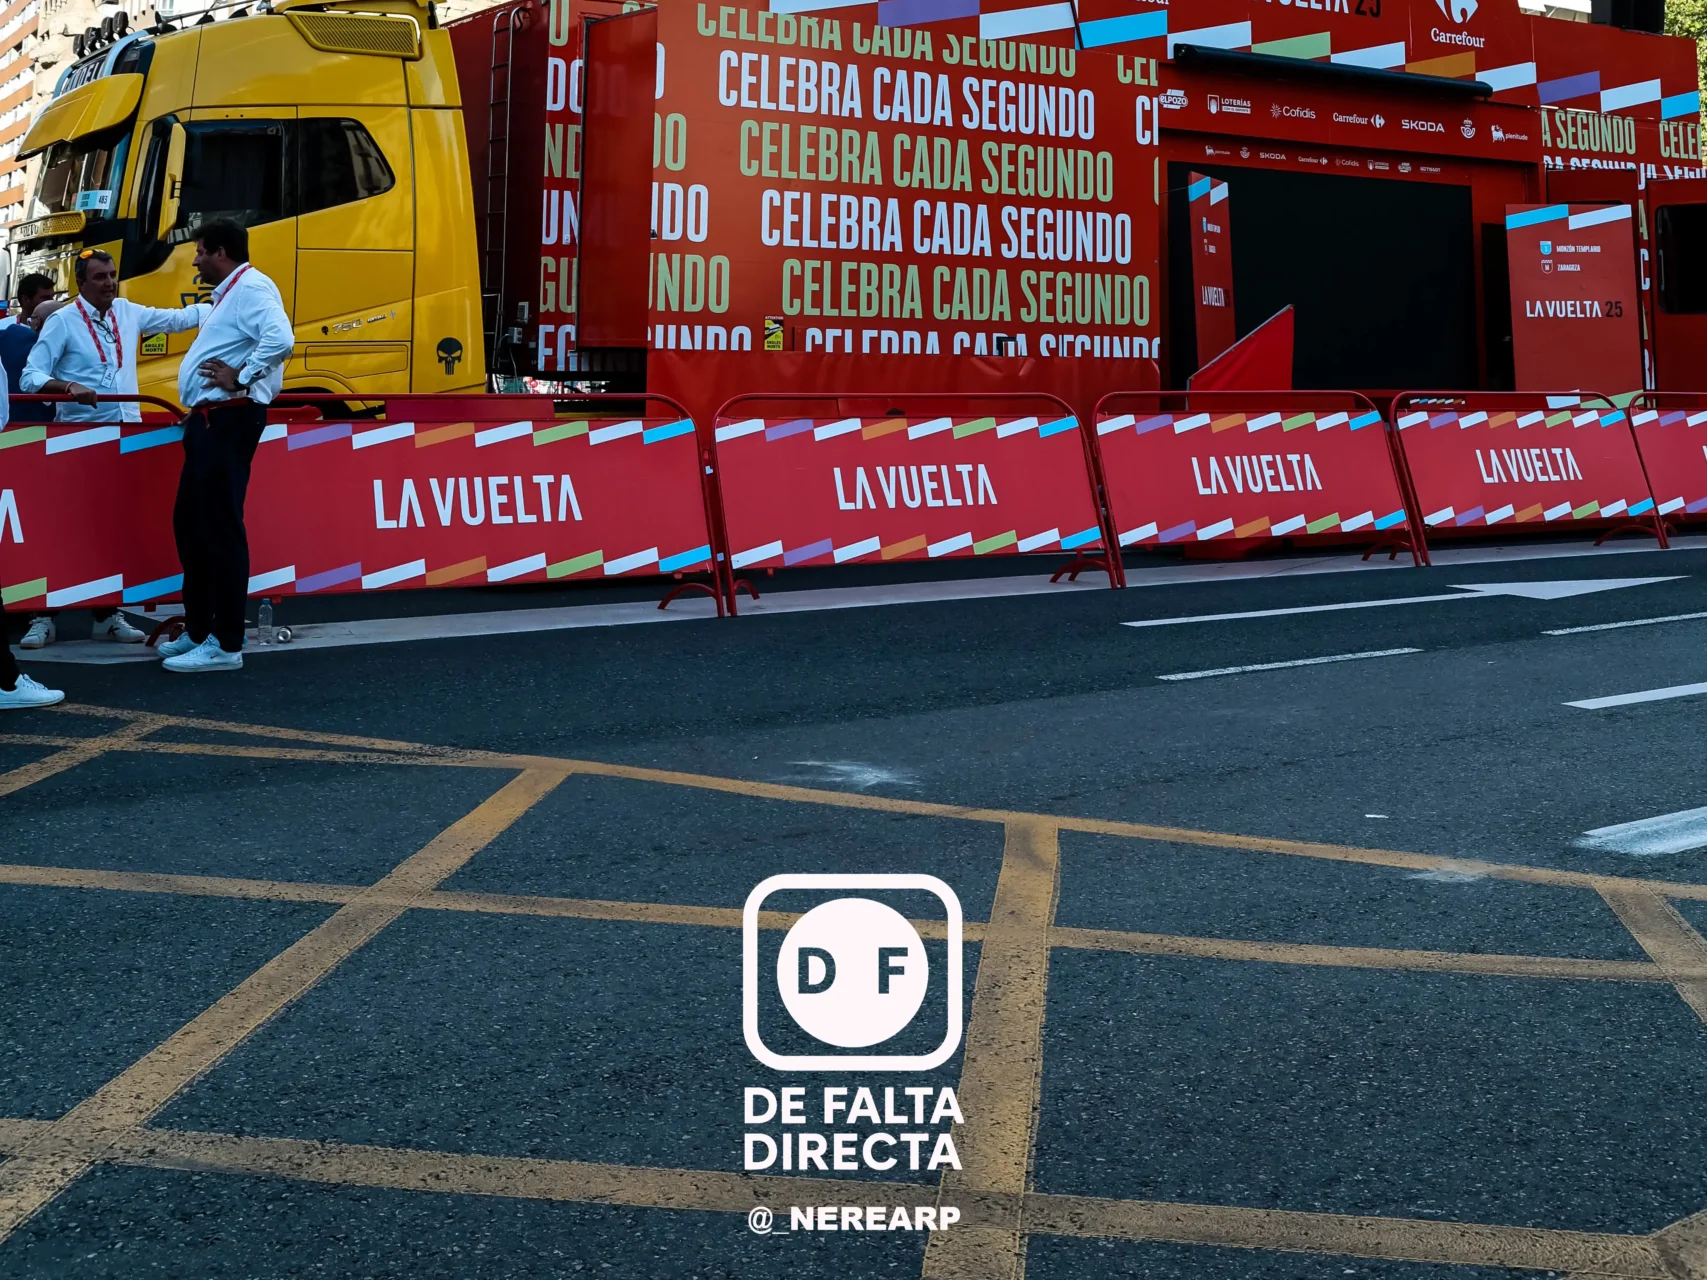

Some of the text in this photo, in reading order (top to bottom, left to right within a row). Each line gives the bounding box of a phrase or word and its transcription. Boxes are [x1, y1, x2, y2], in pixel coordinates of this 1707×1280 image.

[1430, 27, 1485, 49] Carrefour
[719, 50, 862, 118] CELEBRA
[873, 67, 953, 126] CADA
[962, 77, 1095, 141] SEGUNDO
[1282, 105, 1316, 119] Cofidis
[1333, 112, 1369, 125] Carrefour
[1505, 133, 1528, 141] plenitude
[1555, 110, 1637, 155] SEGUNDO
[740, 120, 882, 186] CELEBRA
[894, 134, 972, 192] CADA
[982, 141, 1114, 203] SEGUNDO
[762, 189, 1132, 265] CELEBRA CADA SEGUNDO
[1557, 263, 1581, 272] ZARAGOZA
[782, 259, 1150, 326] CELEBRA CADA SEGUNDO
[1525, 300, 1623, 318] LA VUELTA 25
[1192, 454, 1323, 495] LA VUELTA
[1476, 448, 1583, 483] LA VUELTA
[374, 474, 583, 529] LA VUELTA
[834, 463, 998, 510] LA VUELTA
